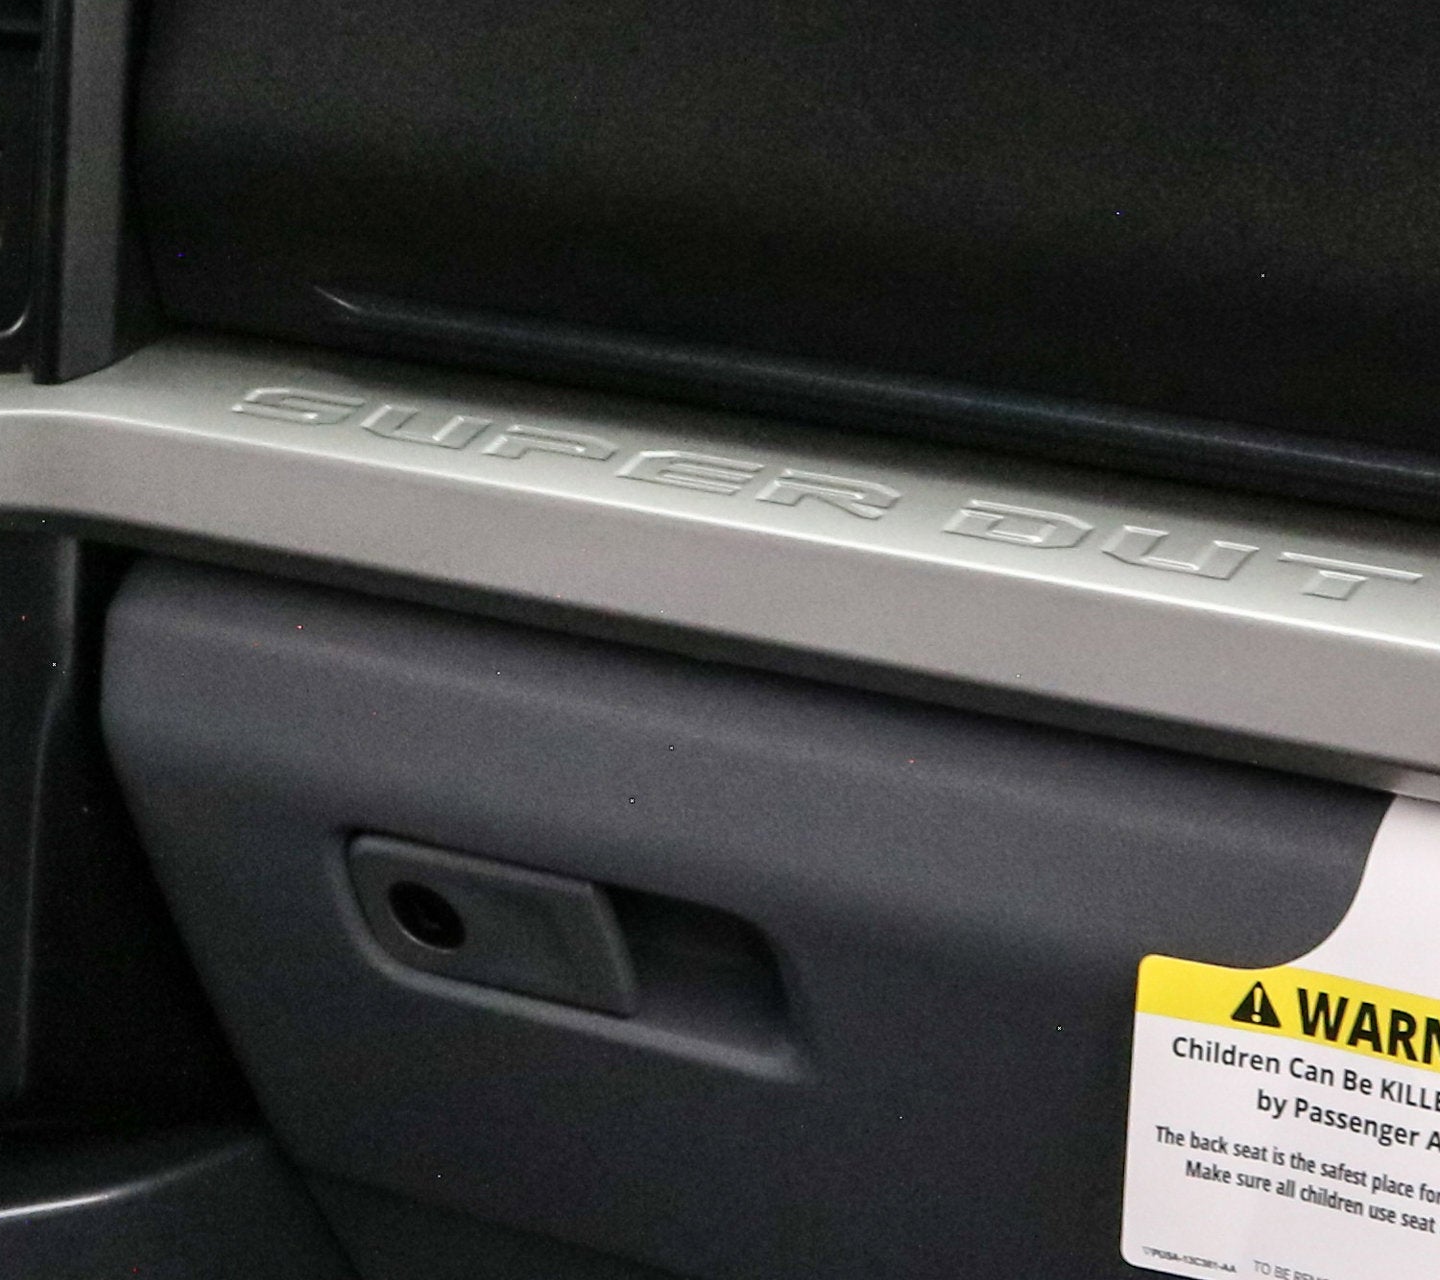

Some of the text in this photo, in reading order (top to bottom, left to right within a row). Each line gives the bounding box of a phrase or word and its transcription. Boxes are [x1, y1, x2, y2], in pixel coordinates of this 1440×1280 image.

[230, 385, 903, 521] SUPER
[1172, 1036, 1280, 1075] Children
[1289, 1057, 1335, 1087] Can
[1342, 1069, 1372, 1095] Be
[1256, 1088, 1287, 1119] by
[1294, 1097, 1421, 1147] Passenger
[1155, 1125, 1185, 1146] The
[1189, 1131, 1229, 1155] back
[1233, 1142, 1269, 1163] seat
[1272, 1146, 1285, 1167] is
[1290, 1152, 1316, 1174] the
[1320, 1163, 1368, 1188] safest
[1371, 1173, 1415, 1199] place
[1185, 1159, 1232, 1184] Make
[1236, 1172, 1272, 1193] sure
[1276, 1178, 1296, 1199] all
[1300, 1184, 1364, 1216] children
[1368, 1204, 1397, 1224] use
[1401, 1211, 1436, 1235] seat
[1253, 1259, 1271, 1276] TO
